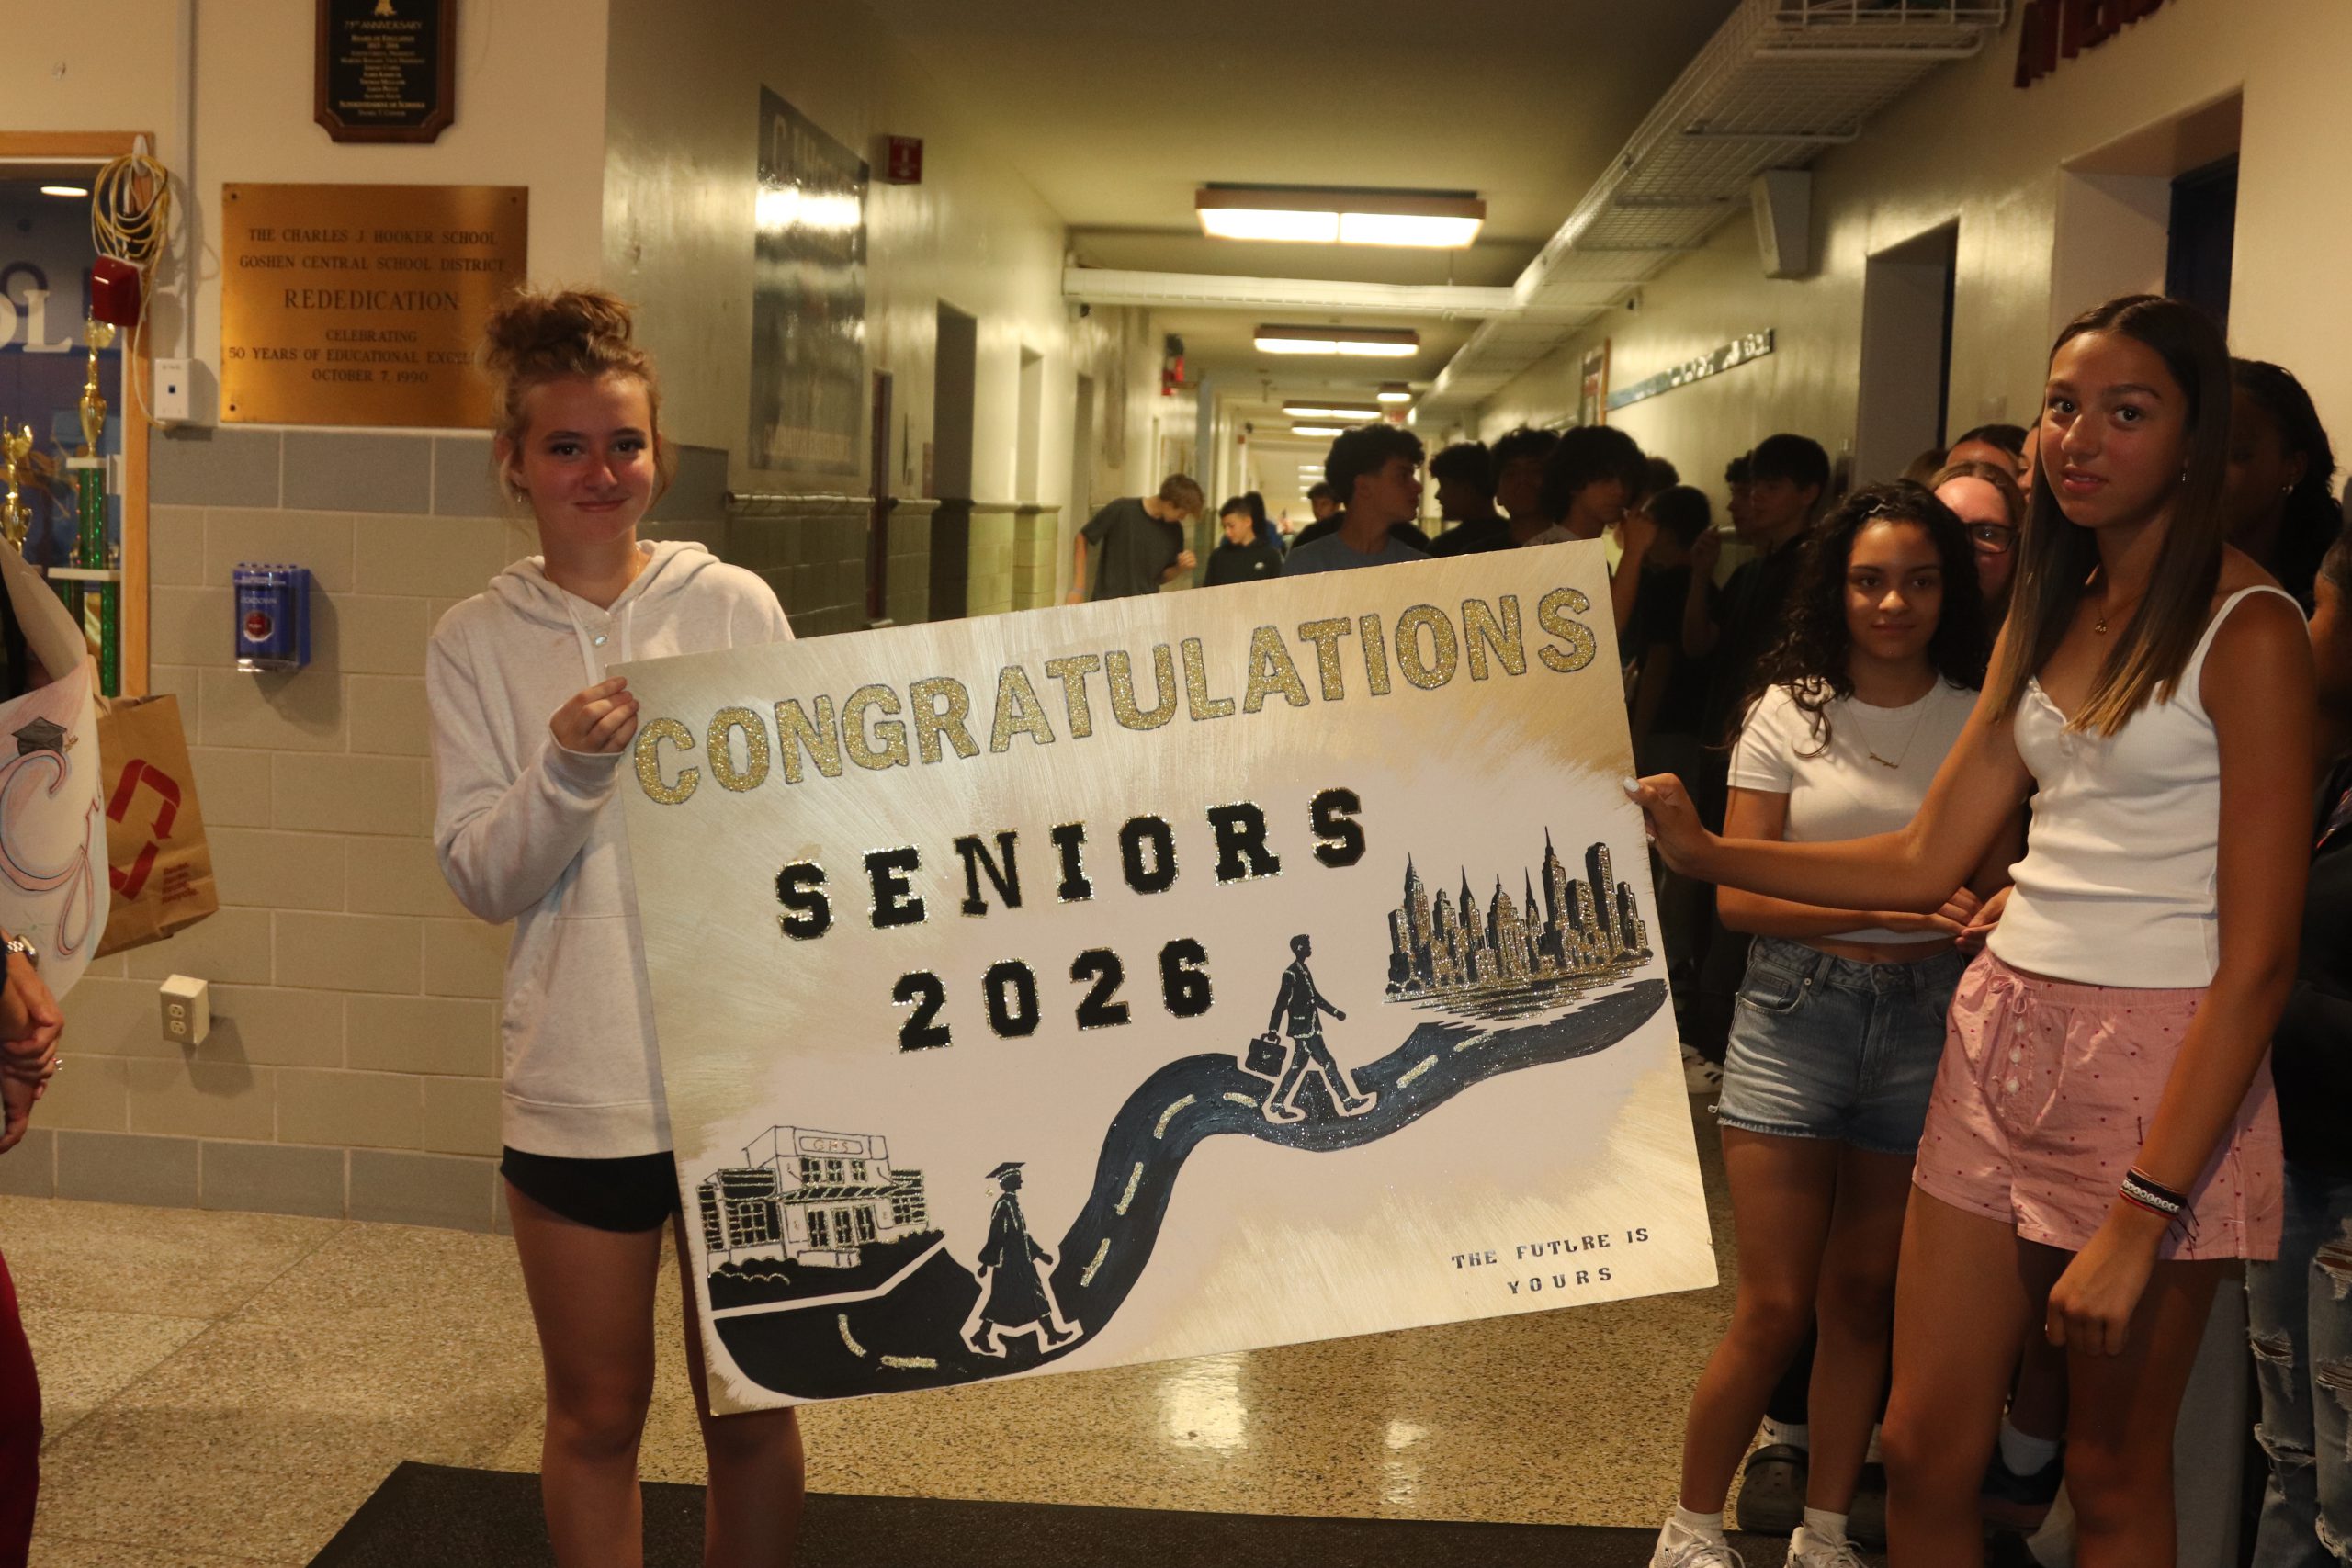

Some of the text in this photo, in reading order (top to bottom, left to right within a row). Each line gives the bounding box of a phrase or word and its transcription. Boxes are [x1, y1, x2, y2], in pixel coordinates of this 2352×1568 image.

[250, 228, 275, 243] THE
[282, 229, 348, 243] CHARLES
[374, 230, 435, 243] HOOKER
[442, 231, 499, 244] SCHOOL
[240, 254, 506, 272] GOSHEN CENTRAL SCHOOL DISTRICT
[284, 288, 458, 310] REDEDICATION
[325, 329, 418, 343] CELEBRATING
[229, 346, 246, 359] 50
[252, 347, 298, 361] YEARS
[303, 348, 321, 362] OF
[326, 349, 419, 364] EDUCATIONAL
[312, 369, 373, 382] OCTOBER
[396, 370, 429, 383] 1990
[634, 586, 1597, 805] CONGRATULATIONS
[775, 786, 1368, 942] SENIORS
[891, 936, 1216, 1055] 2026
[813, 1138, 849, 1154] GHS
[1451, 1227, 1649, 1269] THE FUTURE IS
[1507, 1267, 1612, 1295] YOURS
